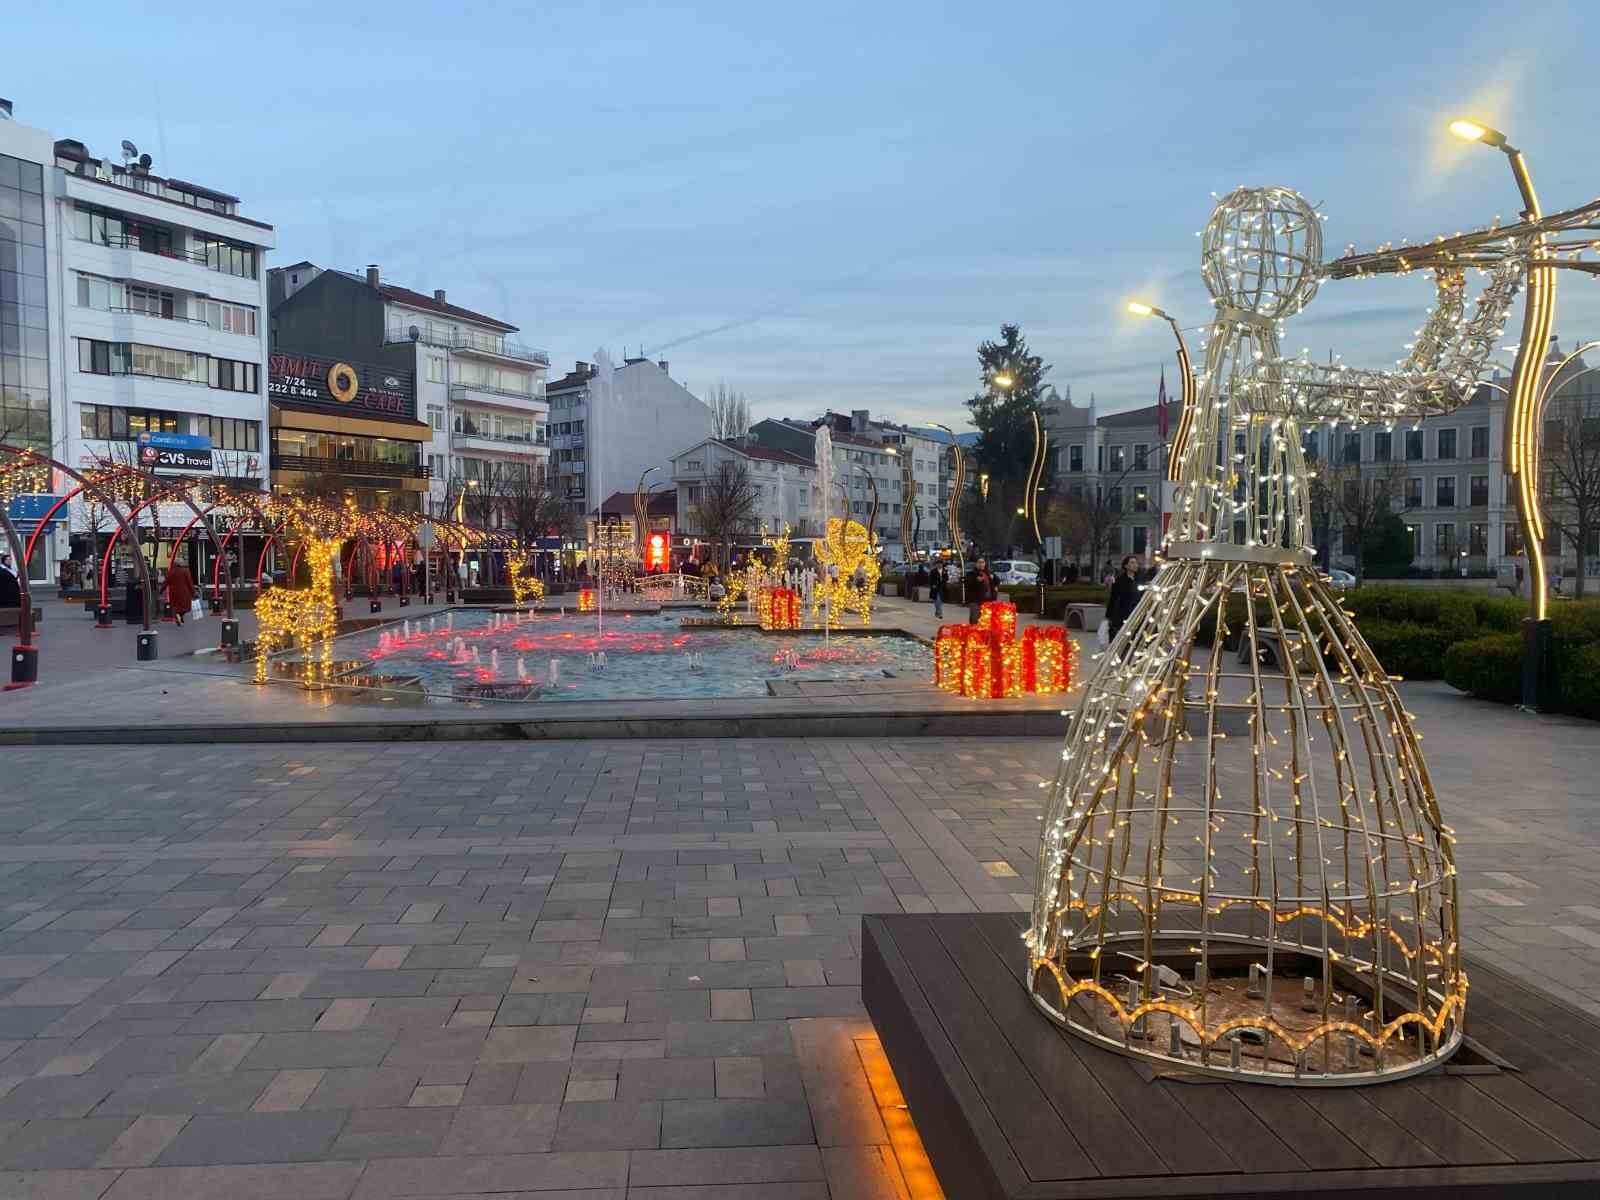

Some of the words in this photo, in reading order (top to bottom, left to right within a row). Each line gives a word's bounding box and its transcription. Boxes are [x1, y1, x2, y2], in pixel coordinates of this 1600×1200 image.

[284, 376, 306, 387] 7/24
[268, 383, 288, 394] 222
[300, 388, 318, 398] 444
[159, 452, 185, 465] CVS
[186, 457, 211, 467] travel
